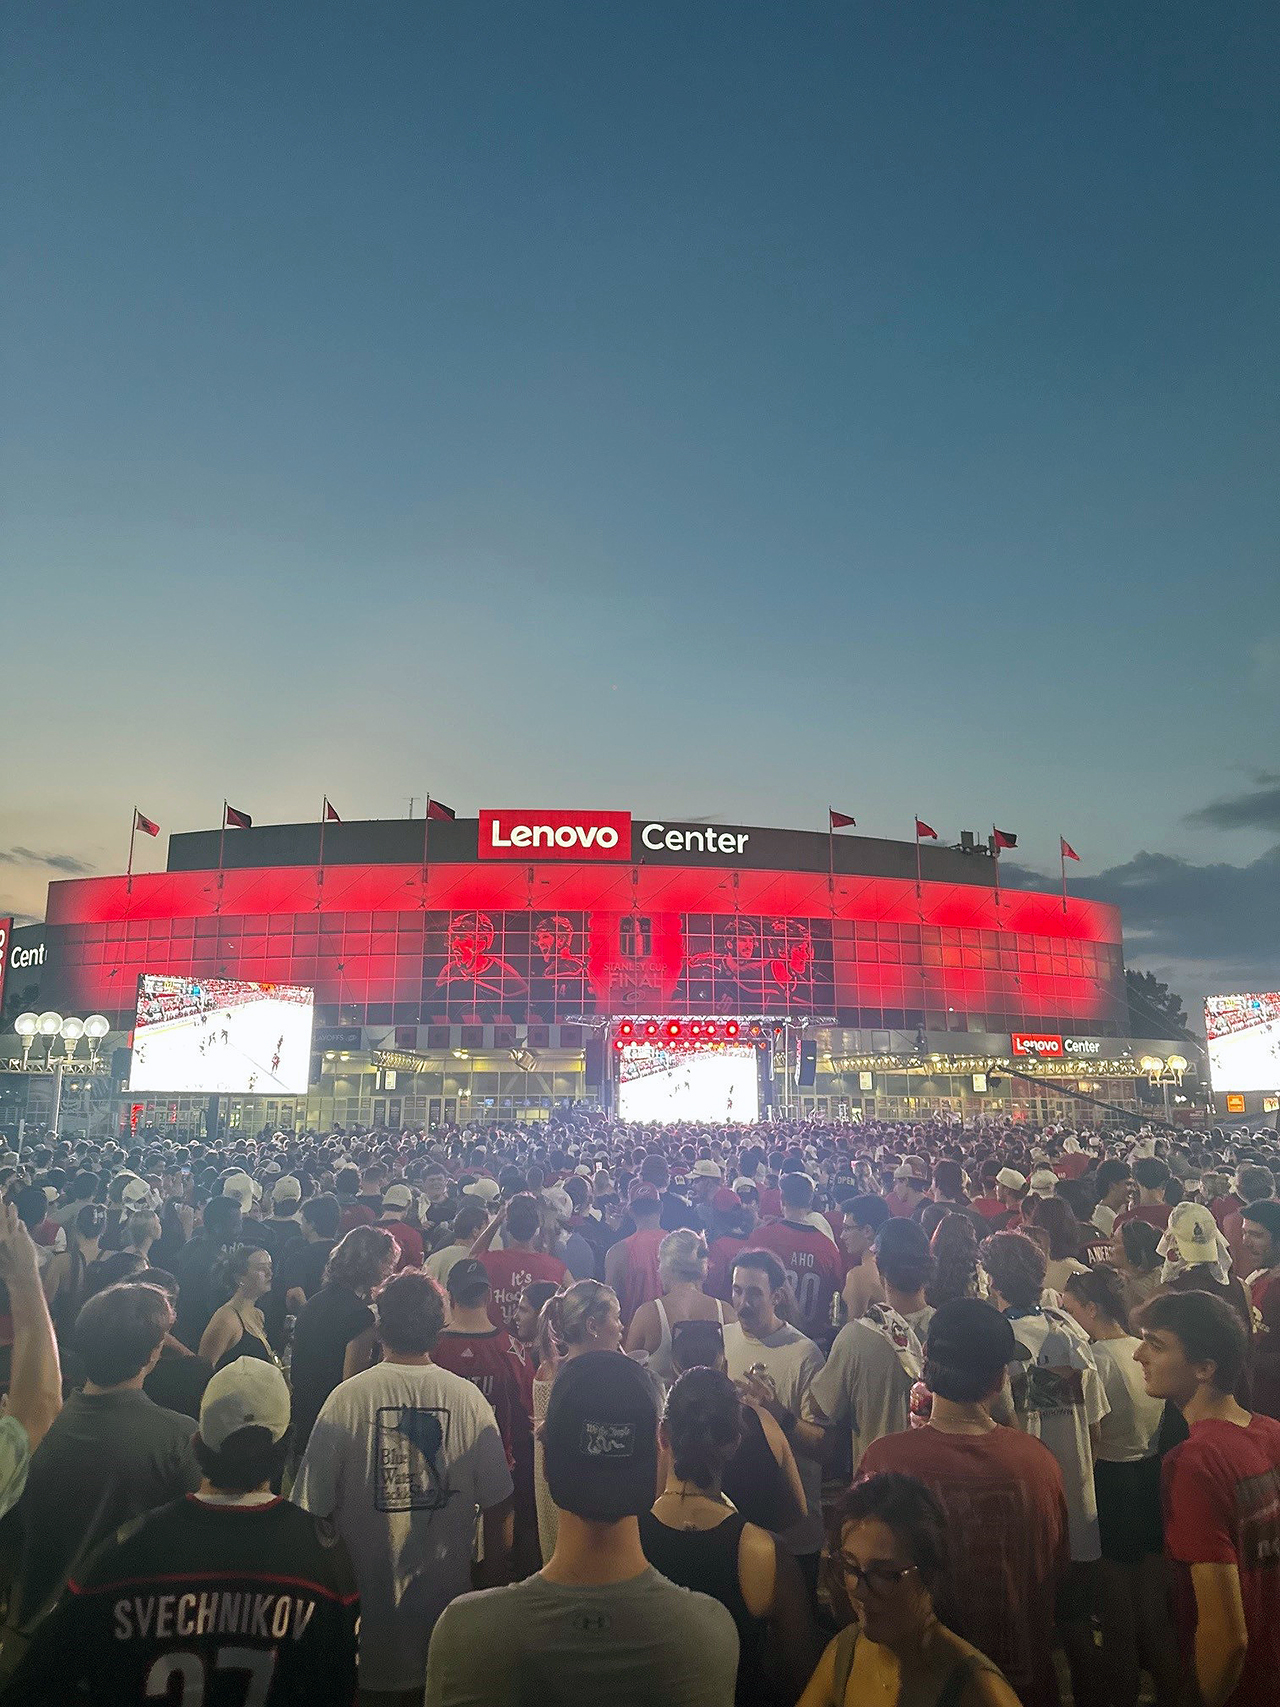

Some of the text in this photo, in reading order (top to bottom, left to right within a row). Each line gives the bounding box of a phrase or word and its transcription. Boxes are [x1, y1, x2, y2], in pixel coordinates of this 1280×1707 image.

[492, 819, 749, 854] Lenovo Center
[11, 943, 48, 968] Cent
[603, 962, 668, 972] STANLEY CUP
[609, 972, 662, 988] FINAL
[1016, 1037, 1100, 1053] Lenovo Center
[790, 1251, 815, 1269] AHO
[511, 1269, 532, 1287] It's
[113, 1592, 316, 1640] SVECHNIKOV
